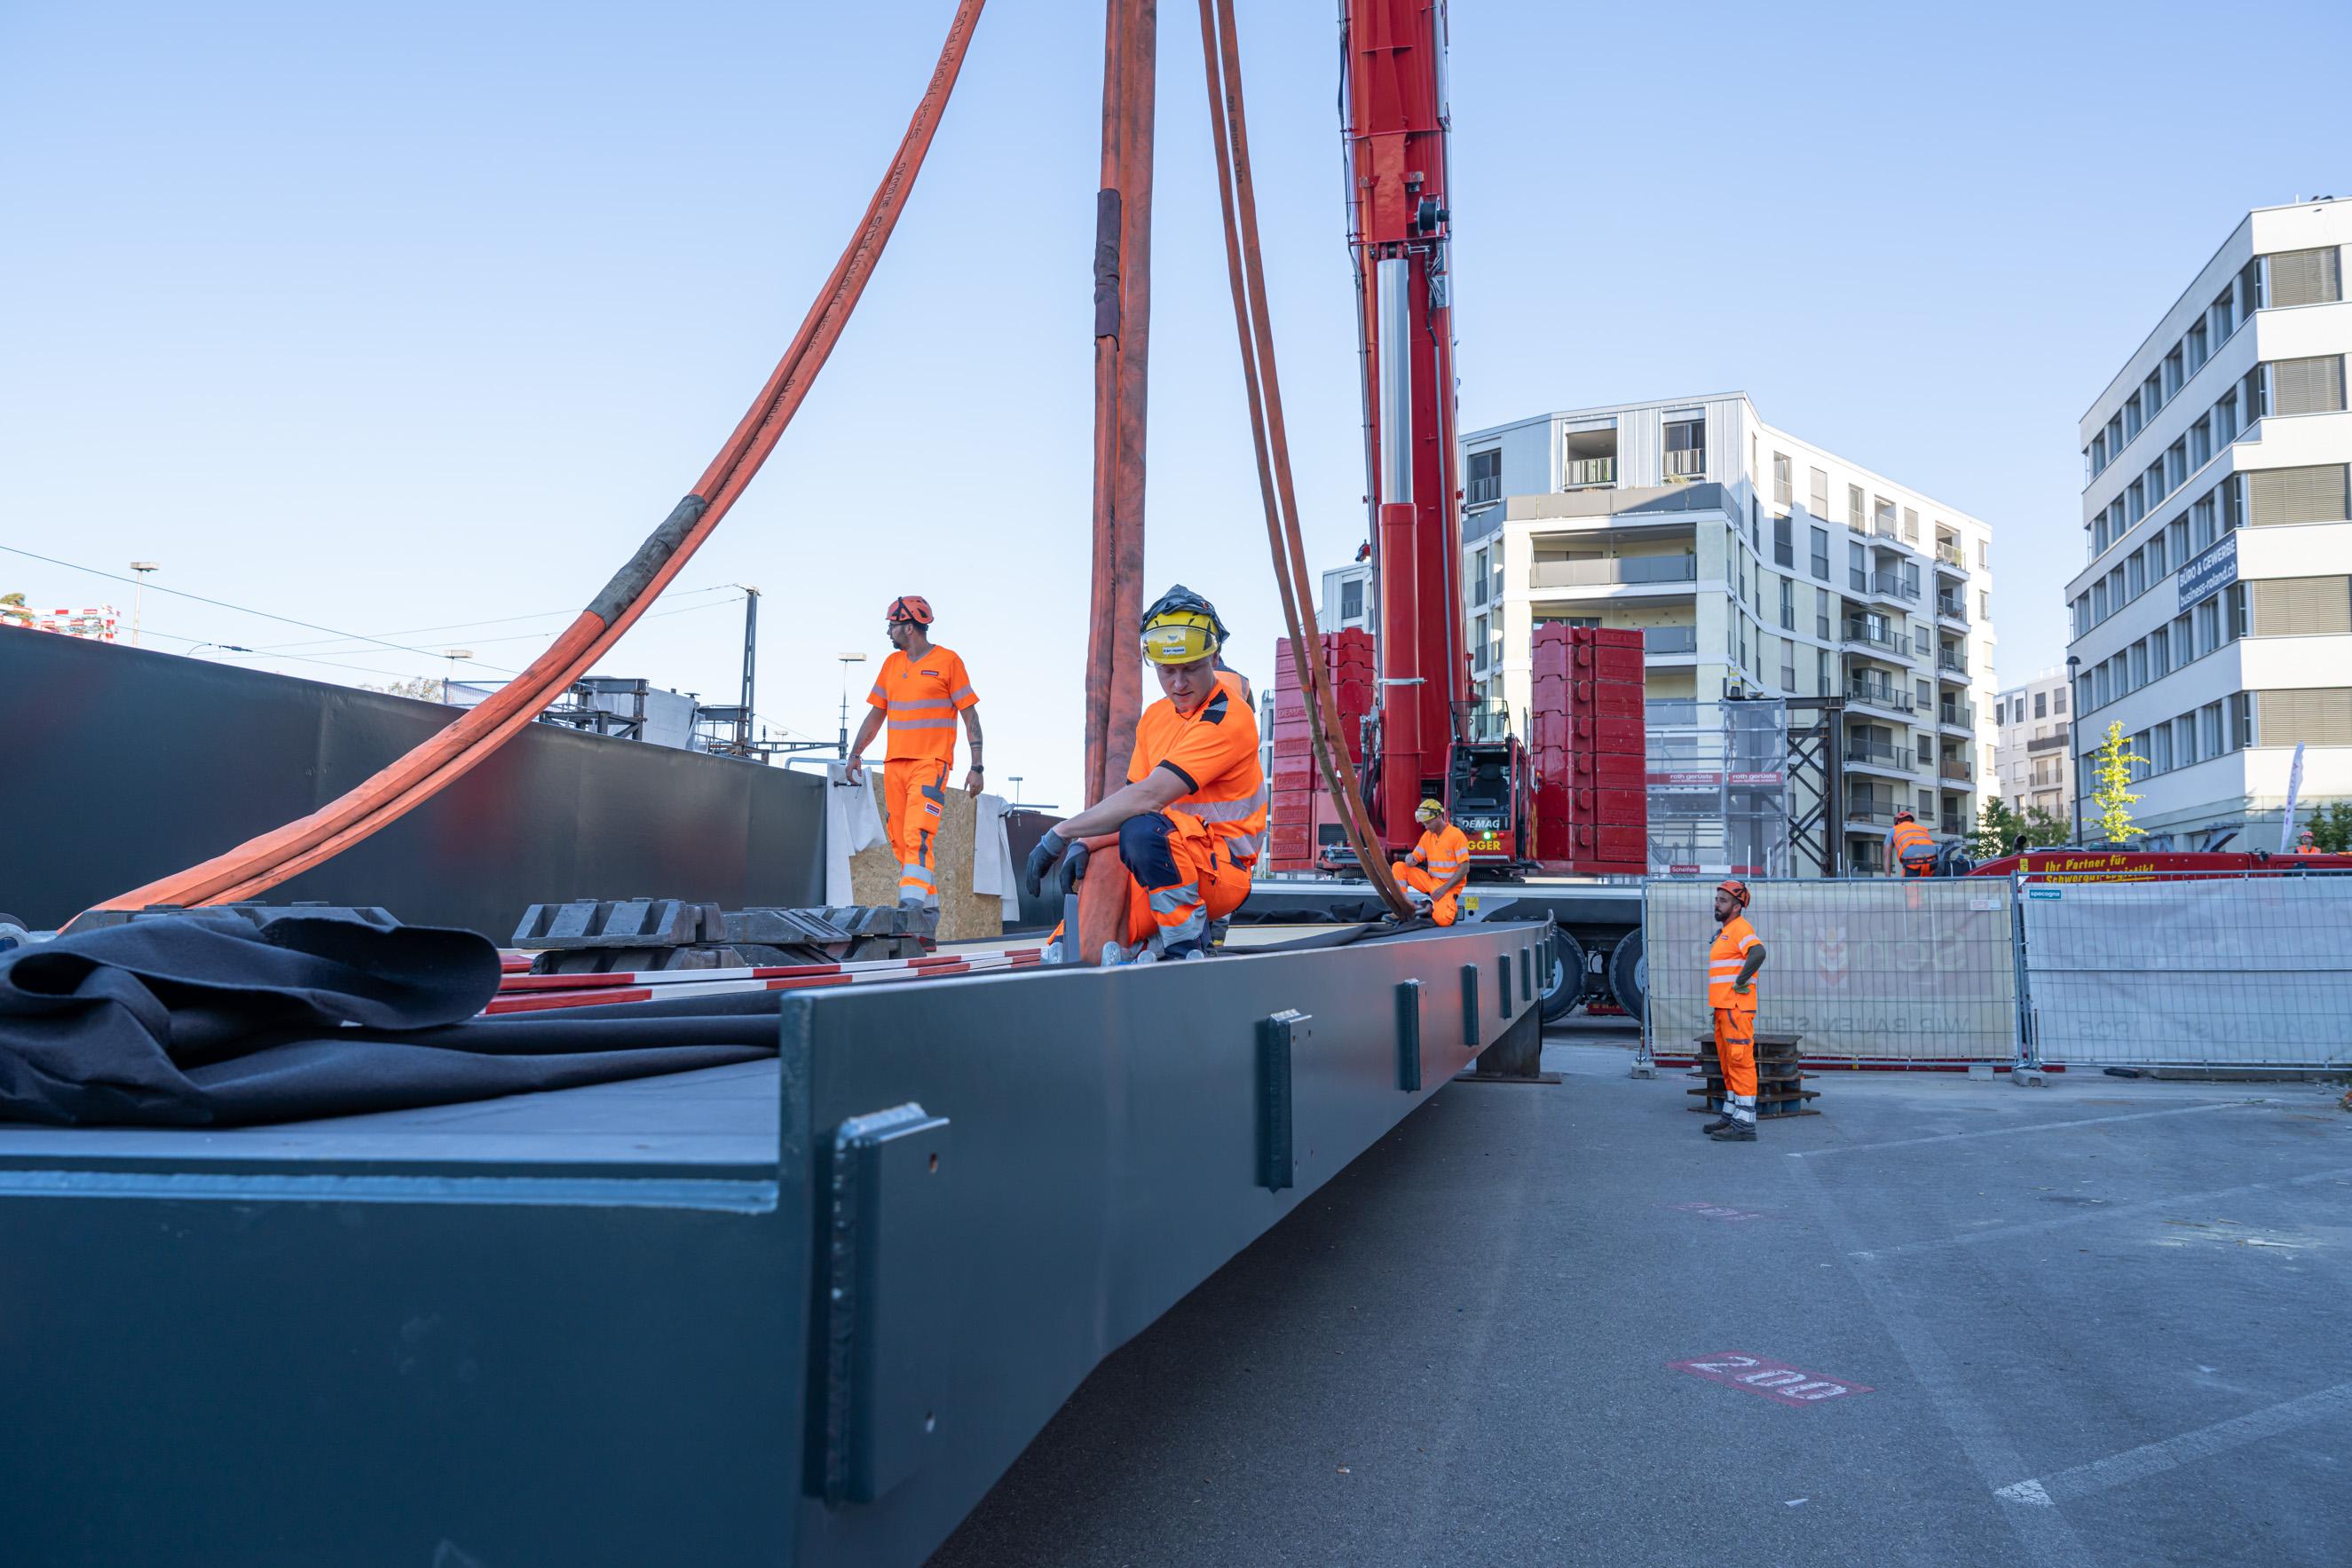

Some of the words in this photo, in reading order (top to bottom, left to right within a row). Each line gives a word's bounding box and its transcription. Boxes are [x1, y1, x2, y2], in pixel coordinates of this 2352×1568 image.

[927, 46, 954, 96] MAGNUM
[949, 11, 967, 43] PLUS
[2179, 565, 2196, 587] BÜRO
[2197, 561, 2203, 575] &
[2203, 538, 2236, 571] GEWERBE
[2180, 561, 2237, 607] business-roland.ch
[1685, 772, 1713, 781] gerüste
[1462, 819, 1500, 829] DEMAG
[2045, 861, 2061, 872] Ihr
[2066, 858, 2106, 871] Partner
[2110, 854, 2127, 866] für
[1689, 1355, 1848, 1400] 200
